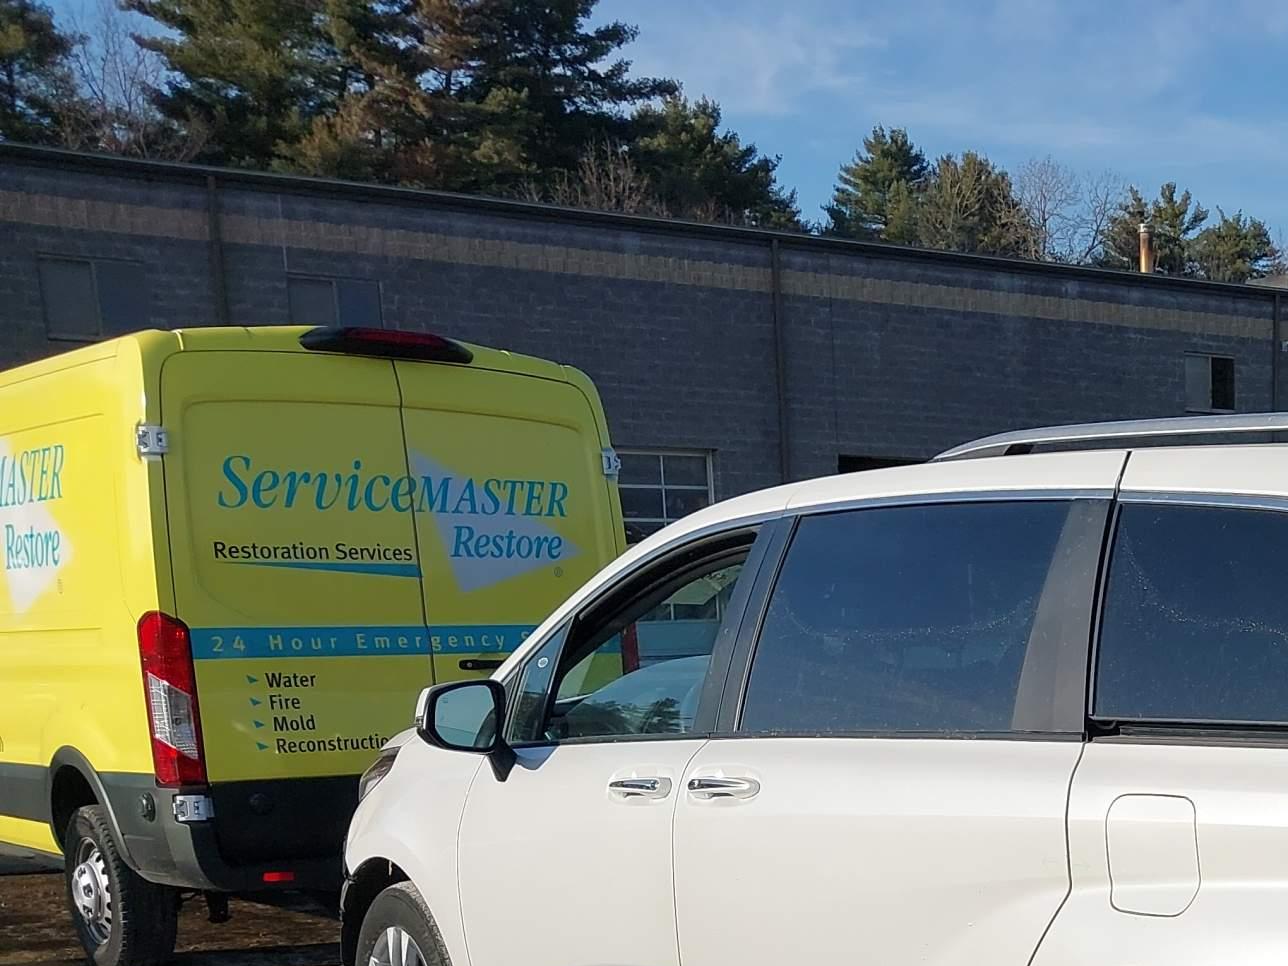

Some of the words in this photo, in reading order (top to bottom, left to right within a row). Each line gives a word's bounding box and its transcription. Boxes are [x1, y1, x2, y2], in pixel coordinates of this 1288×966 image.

[218, 455, 569, 517] ServiceMASTER
[5, 523, 60, 570] Restore
[213, 541, 330, 560] Restoration
[335, 543, 413, 561] Services
[451, 525, 562, 559] Restore
[211, 636, 246, 652] 24
[268, 633, 337, 651] Hour
[355, 632, 505, 651] Emergency
[265, 672, 317, 688] Water
[269, 694, 301, 710] Fire
[273, 714, 316, 731] Mold
[276, 733, 389, 754] Reconstructio
